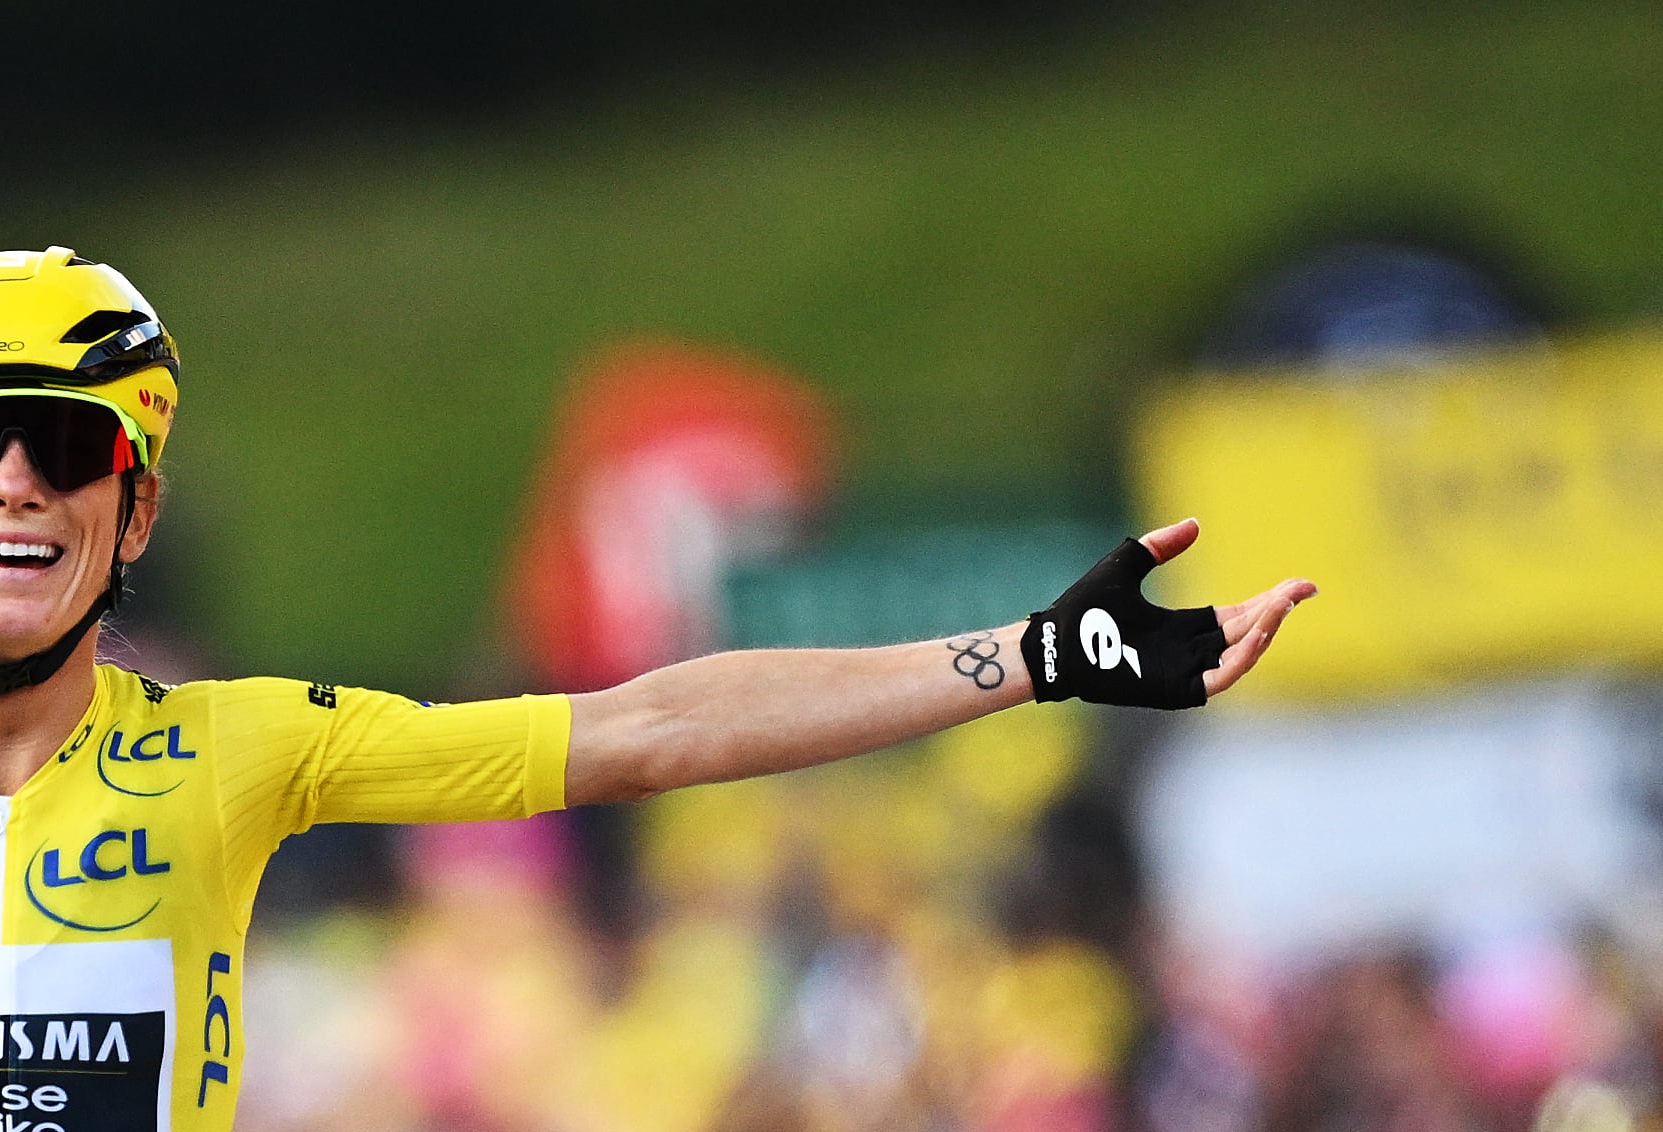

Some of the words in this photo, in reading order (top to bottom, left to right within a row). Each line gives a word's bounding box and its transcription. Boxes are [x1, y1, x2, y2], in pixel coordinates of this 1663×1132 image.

[1041, 621, 1058, 683] GripGrab
[107, 725, 196, 762] LCL
[42, 828, 171, 887] LCL
[197, 951, 231, 1108] LCL
